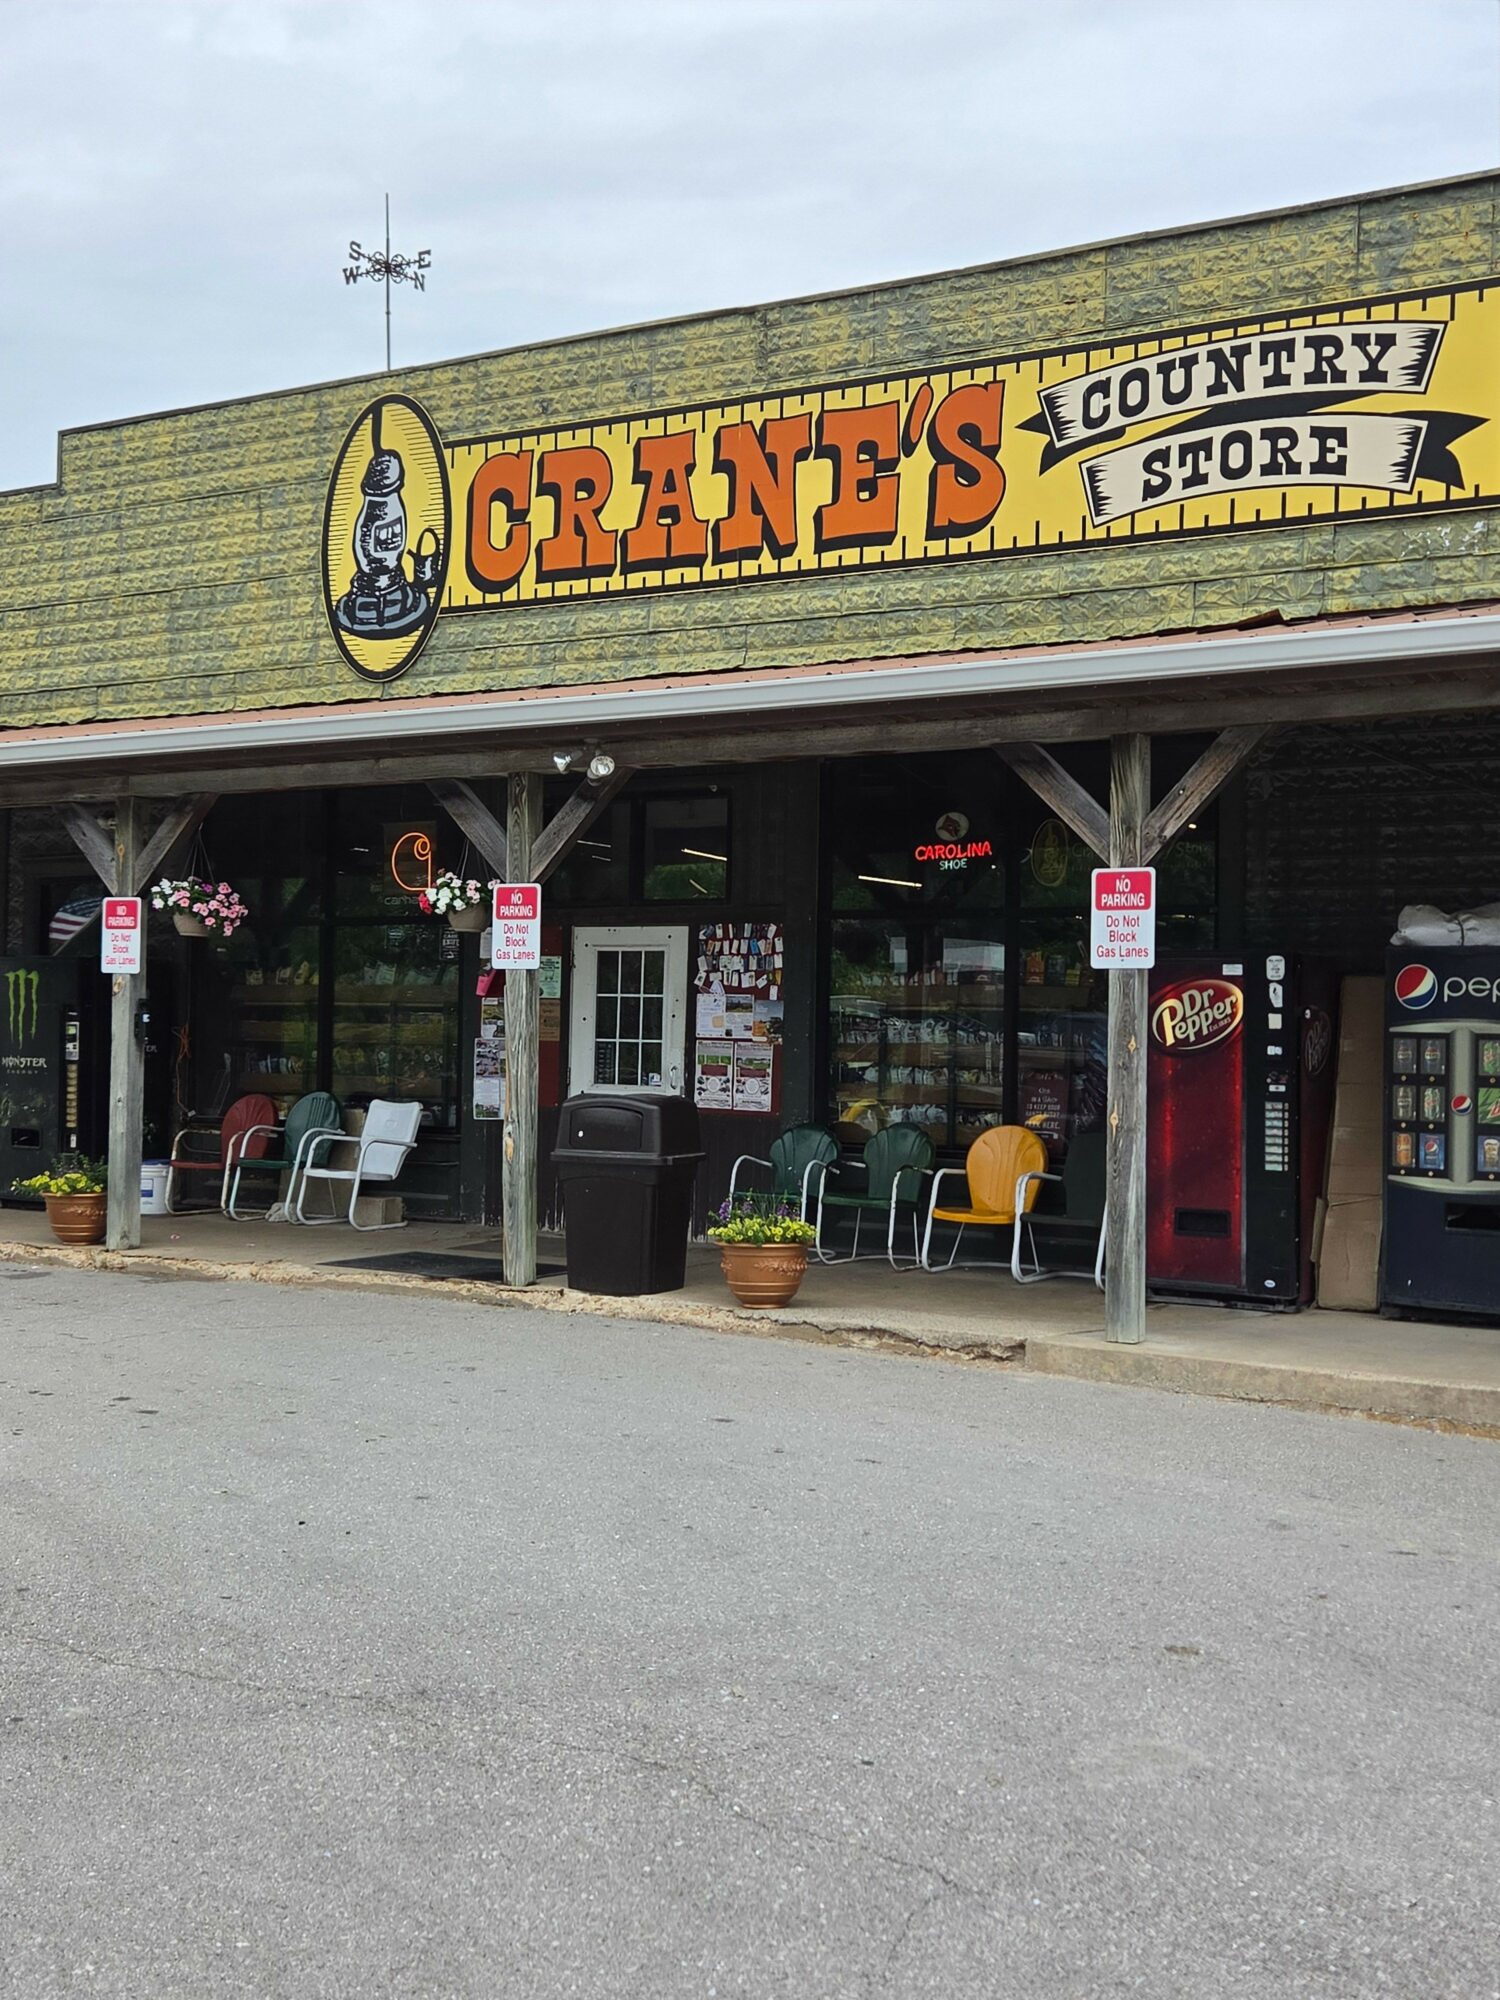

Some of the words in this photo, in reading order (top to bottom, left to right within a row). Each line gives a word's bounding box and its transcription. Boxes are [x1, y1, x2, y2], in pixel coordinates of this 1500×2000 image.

[349, 241, 361, 261] S
[418, 249, 431, 269] E
[342, 265, 360, 285] W
[414, 271, 425, 292] N
[1080, 332, 1397, 430] COUNTRY
[1141, 426, 1349, 502] STORE
[466, 379, 1005, 597] CRANE'S
[914, 840, 993, 861] CAROLINA
[939, 858, 968, 870] SHOE
[1115, 878, 1131, 892] NO
[511, 893, 523, 904] NO
[1101, 892, 1145, 907] PARKING
[500, 905, 533, 917] PARKING
[107, 916, 136, 927] PARKING
[1106, 915, 1120, 927] Do
[1123, 915, 1140, 927] Not
[503, 924, 514, 934] Do
[516, 923, 529, 934] Not
[505, 936, 527, 947] Block
[1109, 930, 1137, 942] Block
[496, 949, 511, 960] Gas
[513, 949, 536, 960] Lanes
[1096, 945, 1116, 958] Gas
[1119, 945, 1149, 958] Lanes
[1181, 988, 1215, 1018] Dr
[1153, 995, 1237, 1047] Pepper
[1, 1056, 48, 1068] MONSTER
